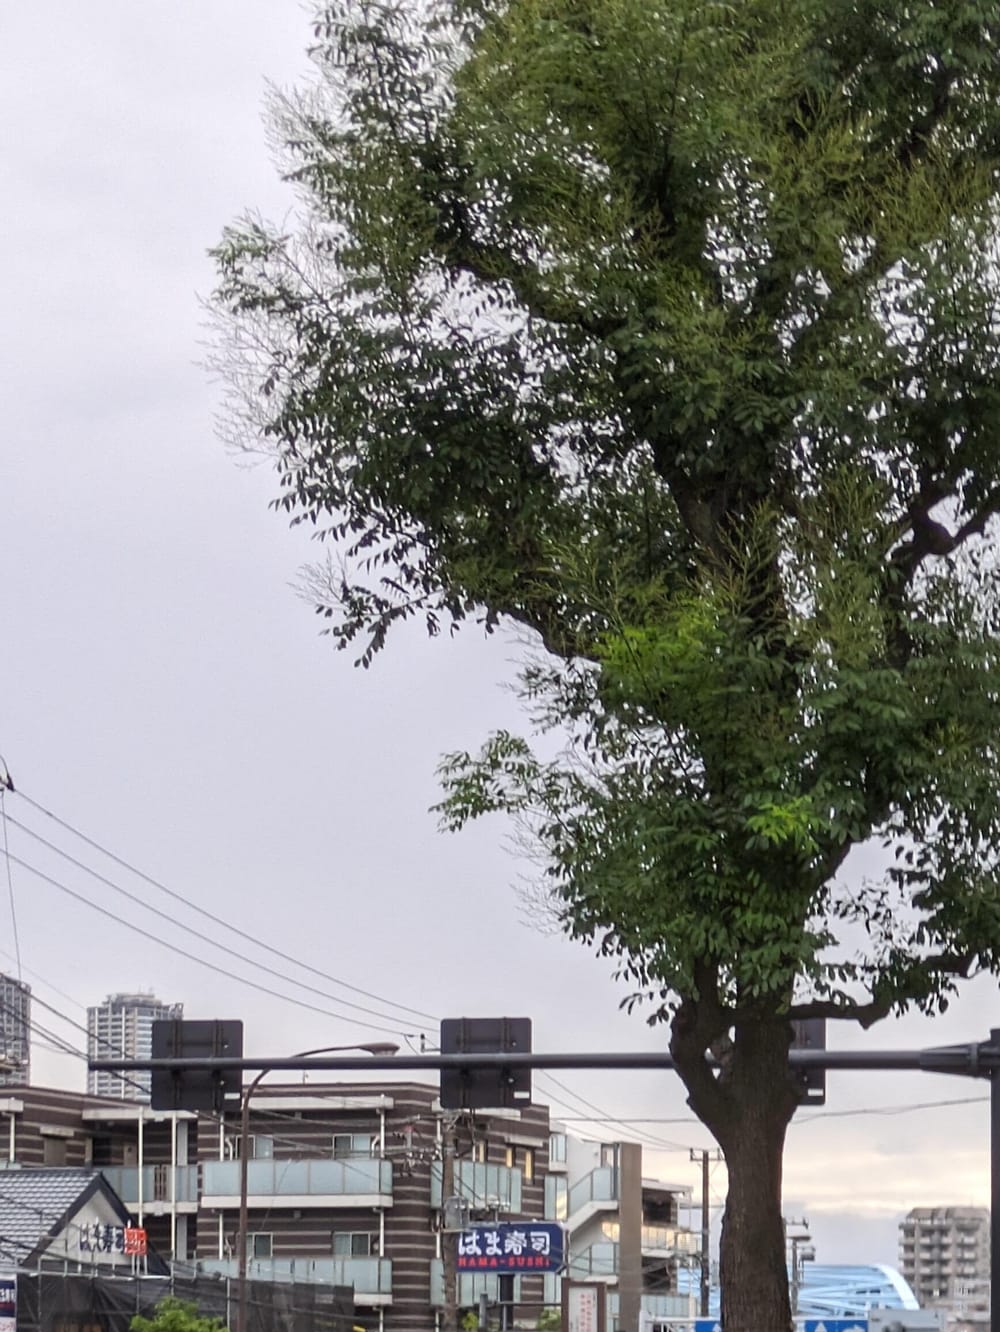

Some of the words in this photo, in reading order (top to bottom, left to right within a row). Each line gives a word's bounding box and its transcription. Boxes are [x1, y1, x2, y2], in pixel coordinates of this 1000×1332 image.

[458, 1230, 550, 1255] はま寿司
[458, 1256, 550, 1267] HAMA-SUSHI
